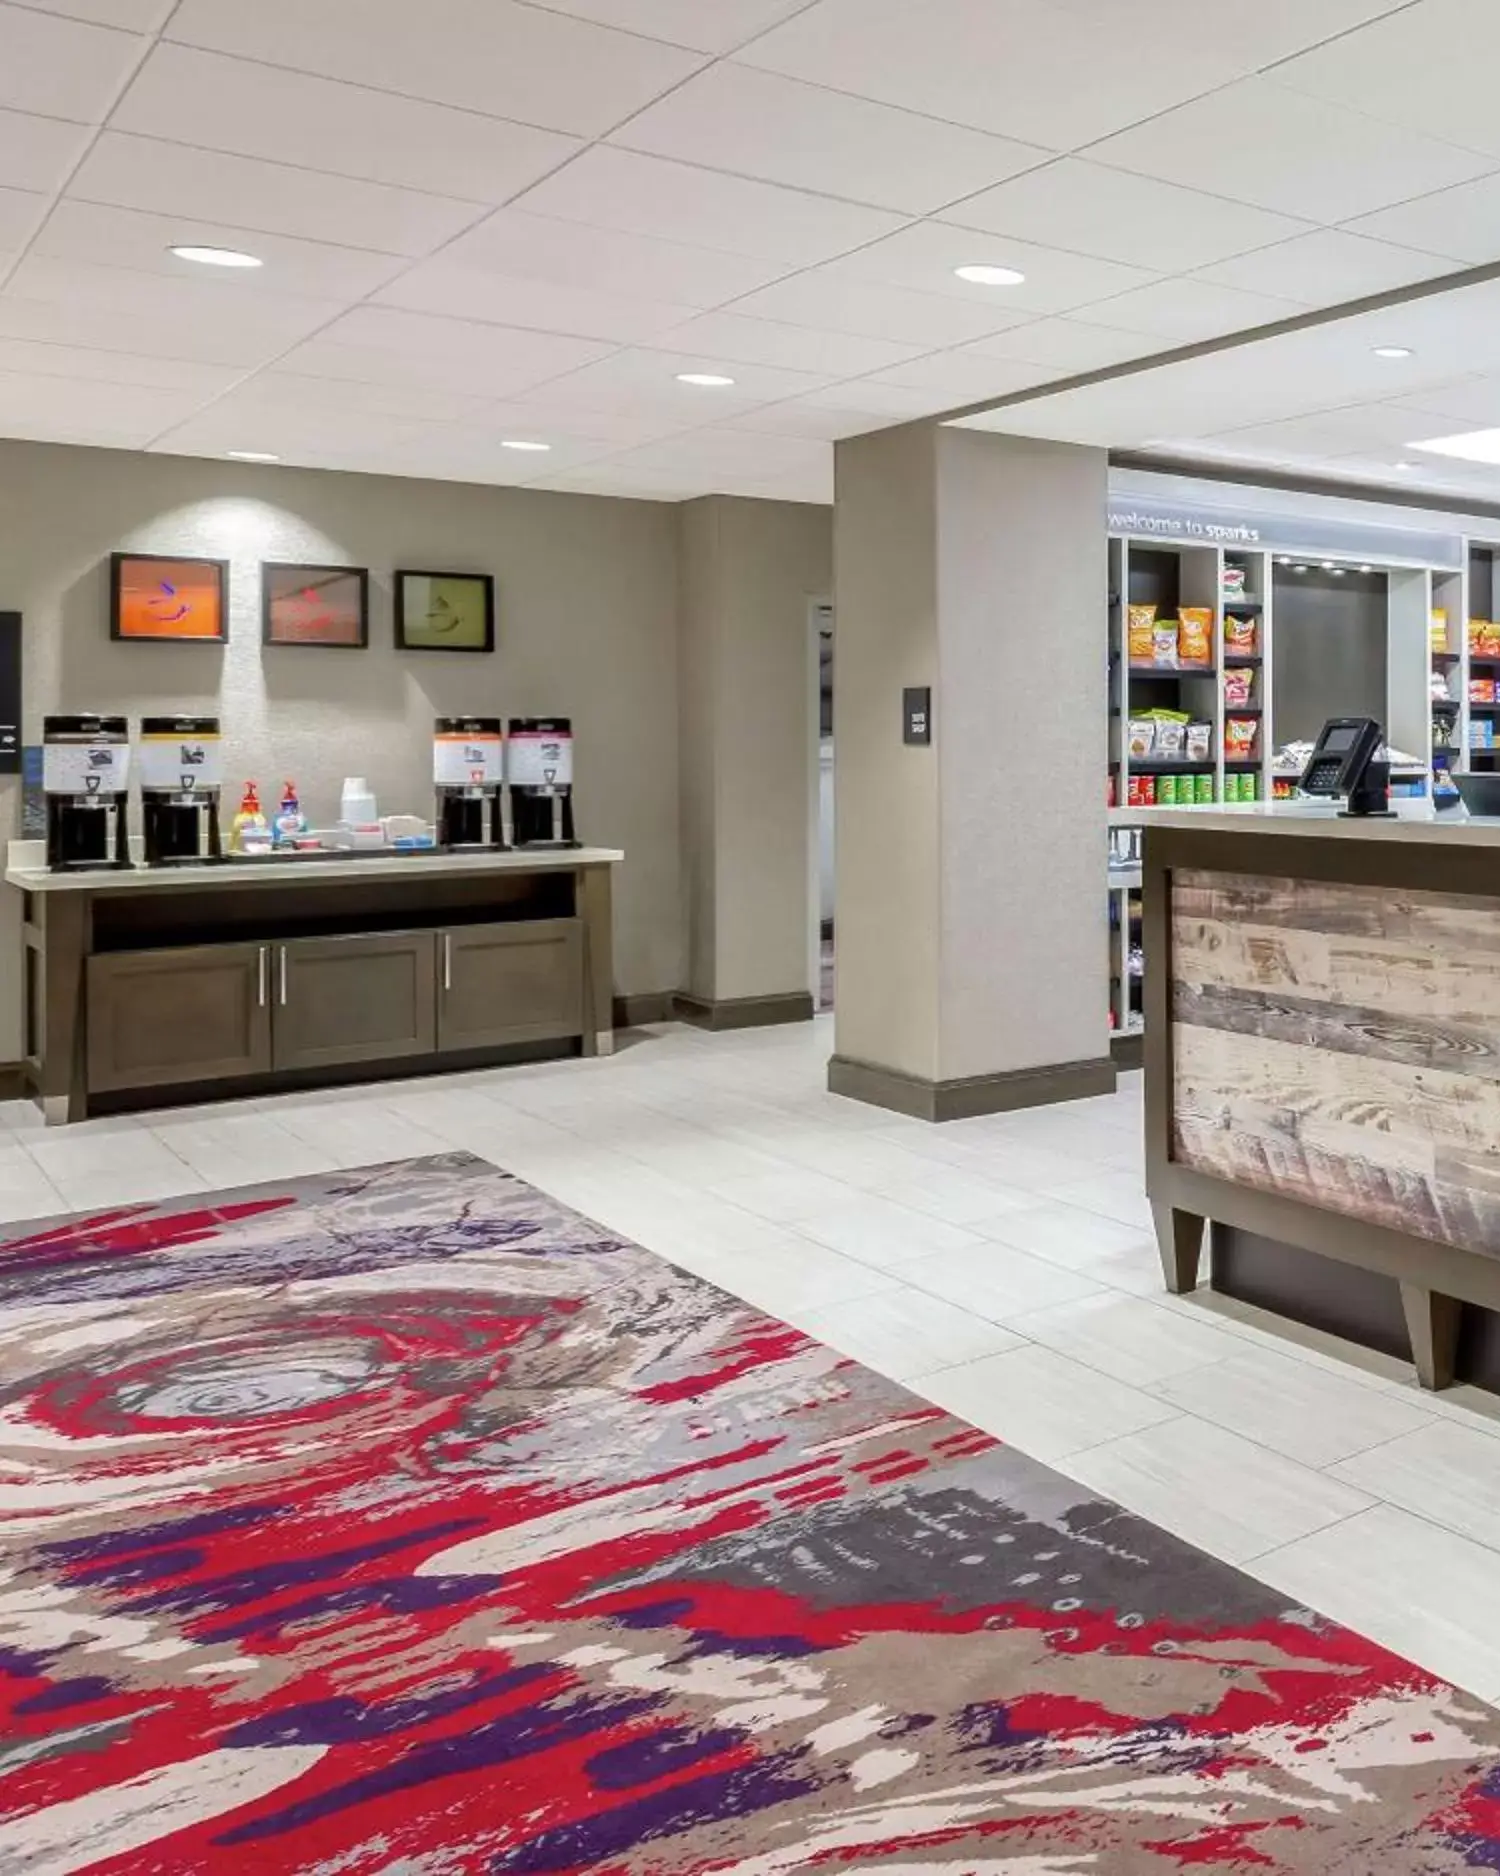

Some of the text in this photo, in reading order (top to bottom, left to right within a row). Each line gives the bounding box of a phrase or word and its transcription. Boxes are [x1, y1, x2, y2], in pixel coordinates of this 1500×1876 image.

[1107, 511, 1259, 543] welcome to sparks
